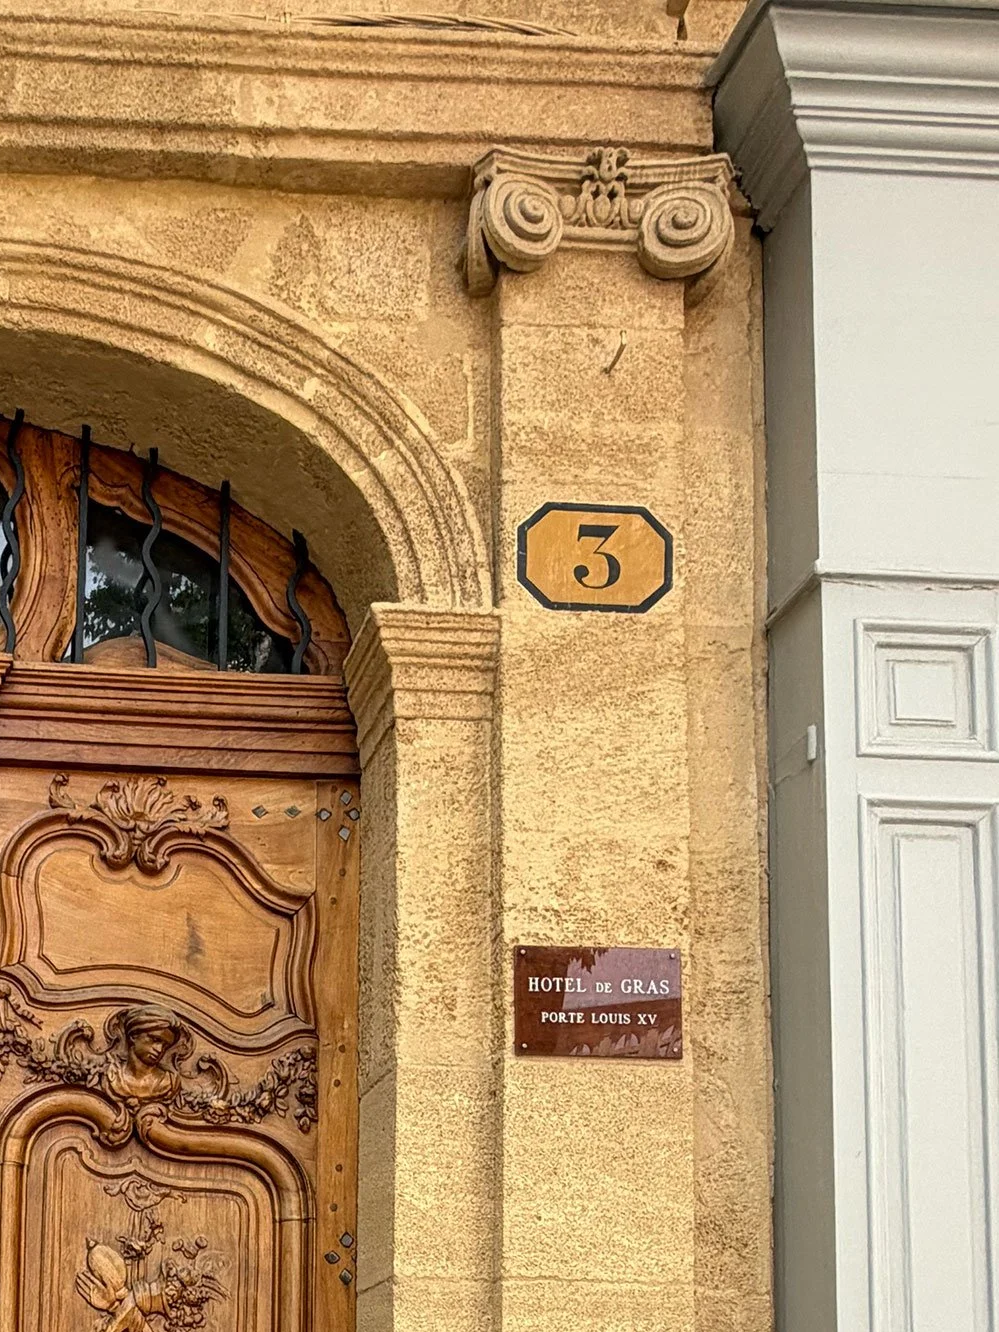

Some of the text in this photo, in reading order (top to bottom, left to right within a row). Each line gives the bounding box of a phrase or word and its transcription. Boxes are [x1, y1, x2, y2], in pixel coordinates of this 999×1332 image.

[574, 524, 620, 589] 3
[528, 977, 669, 994] HOTEL DE GRAS
[541, 1012, 657, 1025] PORTE LOUIS XV
